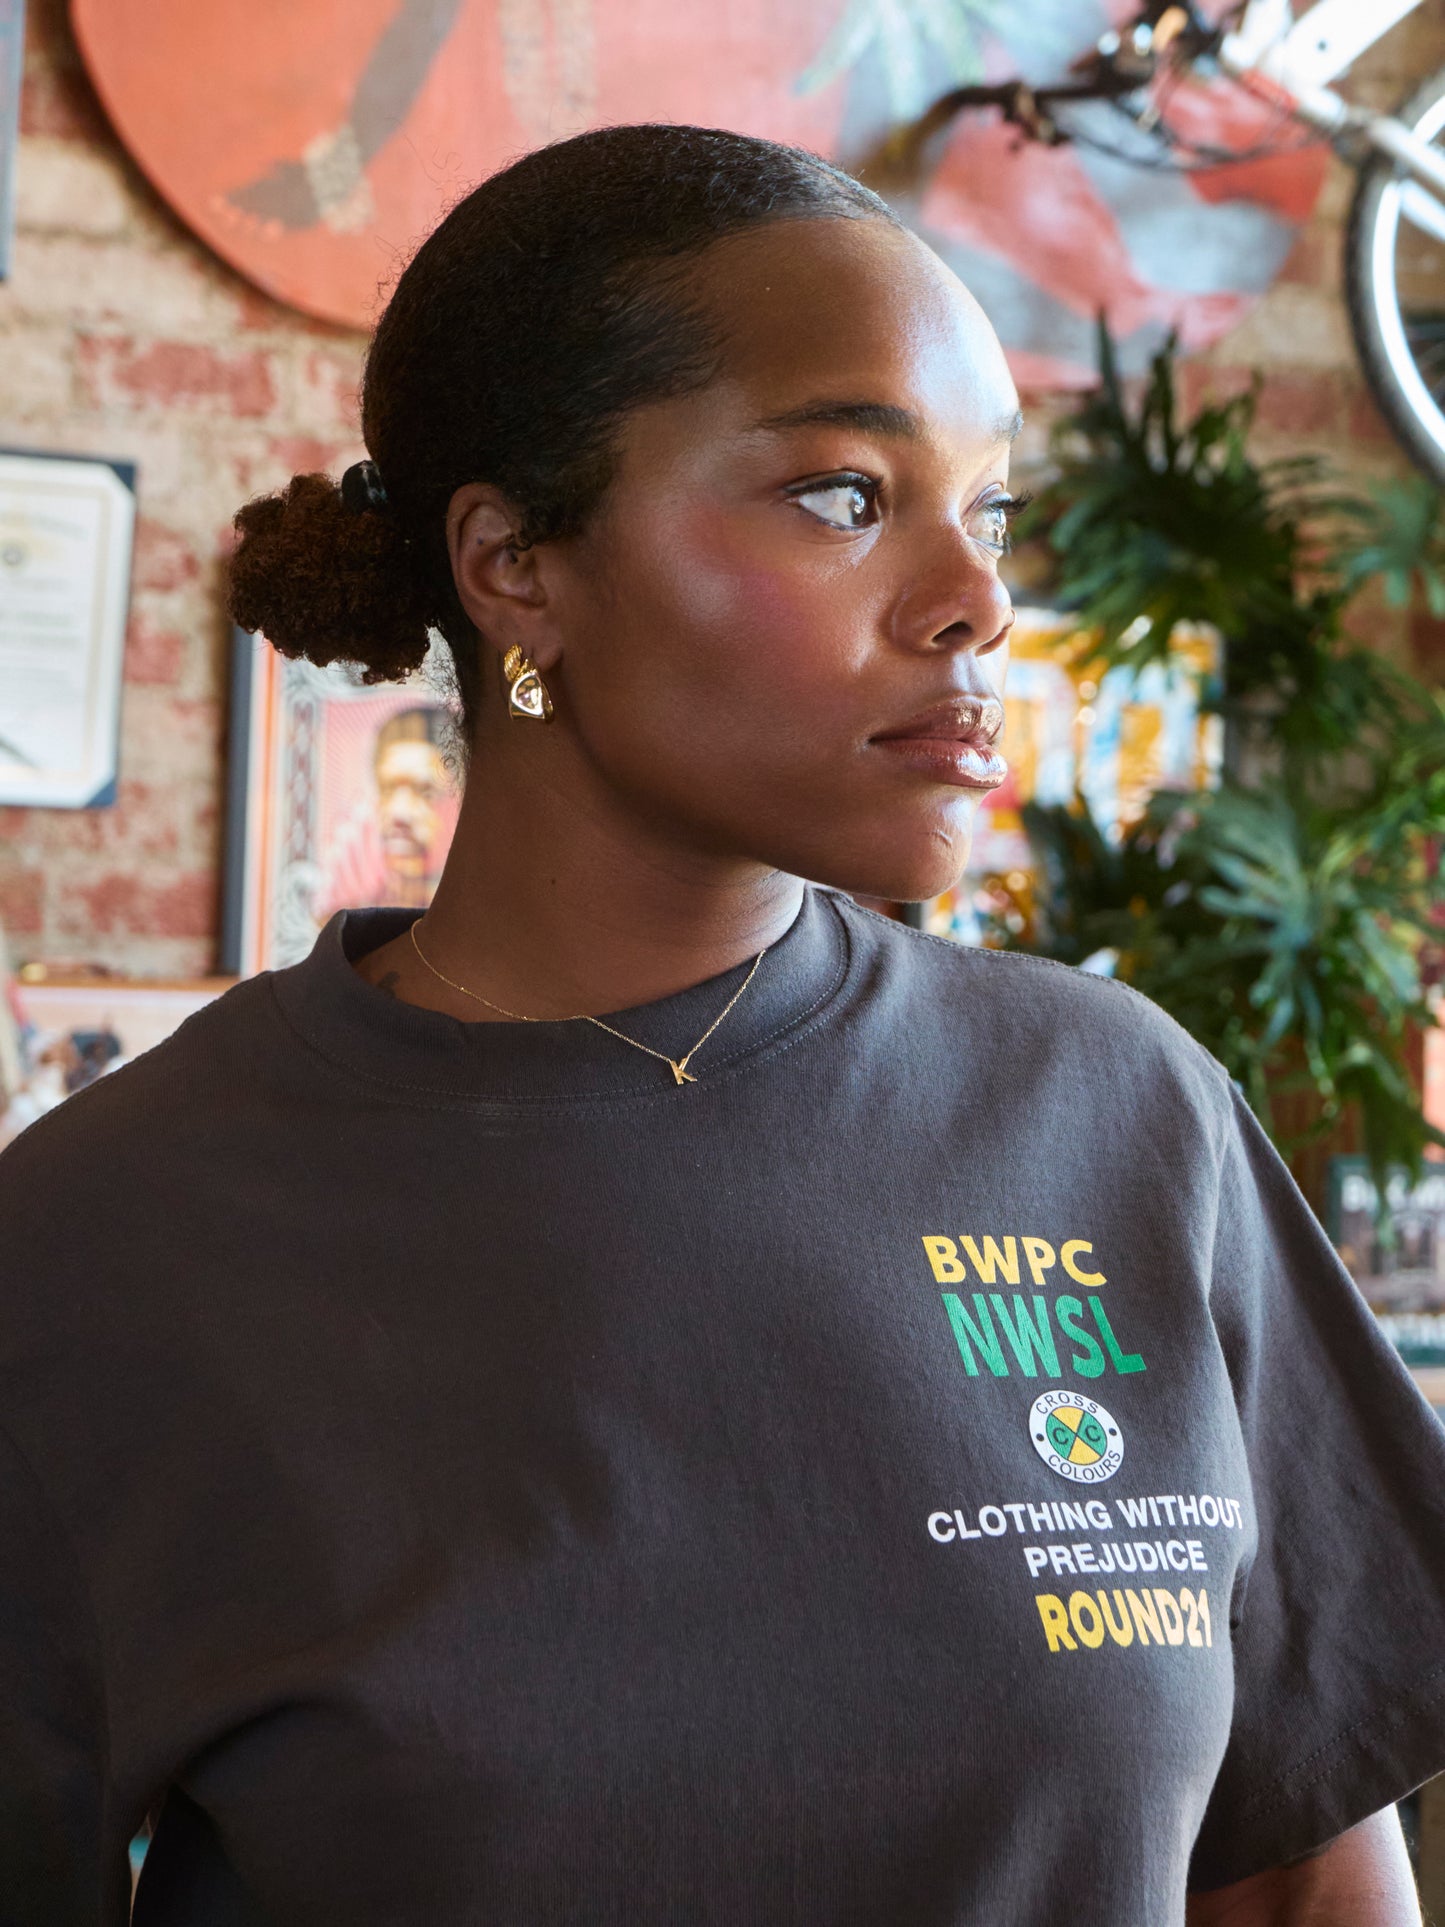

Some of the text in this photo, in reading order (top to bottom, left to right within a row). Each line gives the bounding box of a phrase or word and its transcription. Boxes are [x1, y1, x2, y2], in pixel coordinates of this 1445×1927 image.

[921, 1235, 1108, 1287] BWPC
[941, 1293, 1147, 1378] NWSL
[1036, 1392, 1098, 1414] CROSS
[1052, 1425, 1101, 1445] C C
[1048, 1450, 1121, 1481] COLOURS
[927, 1495, 1243, 1543] CLOTHING WITHOUT
[1023, 1540, 1208, 1577] PREJUDICE
[1035, 1587, 1212, 1653] ROUND21
